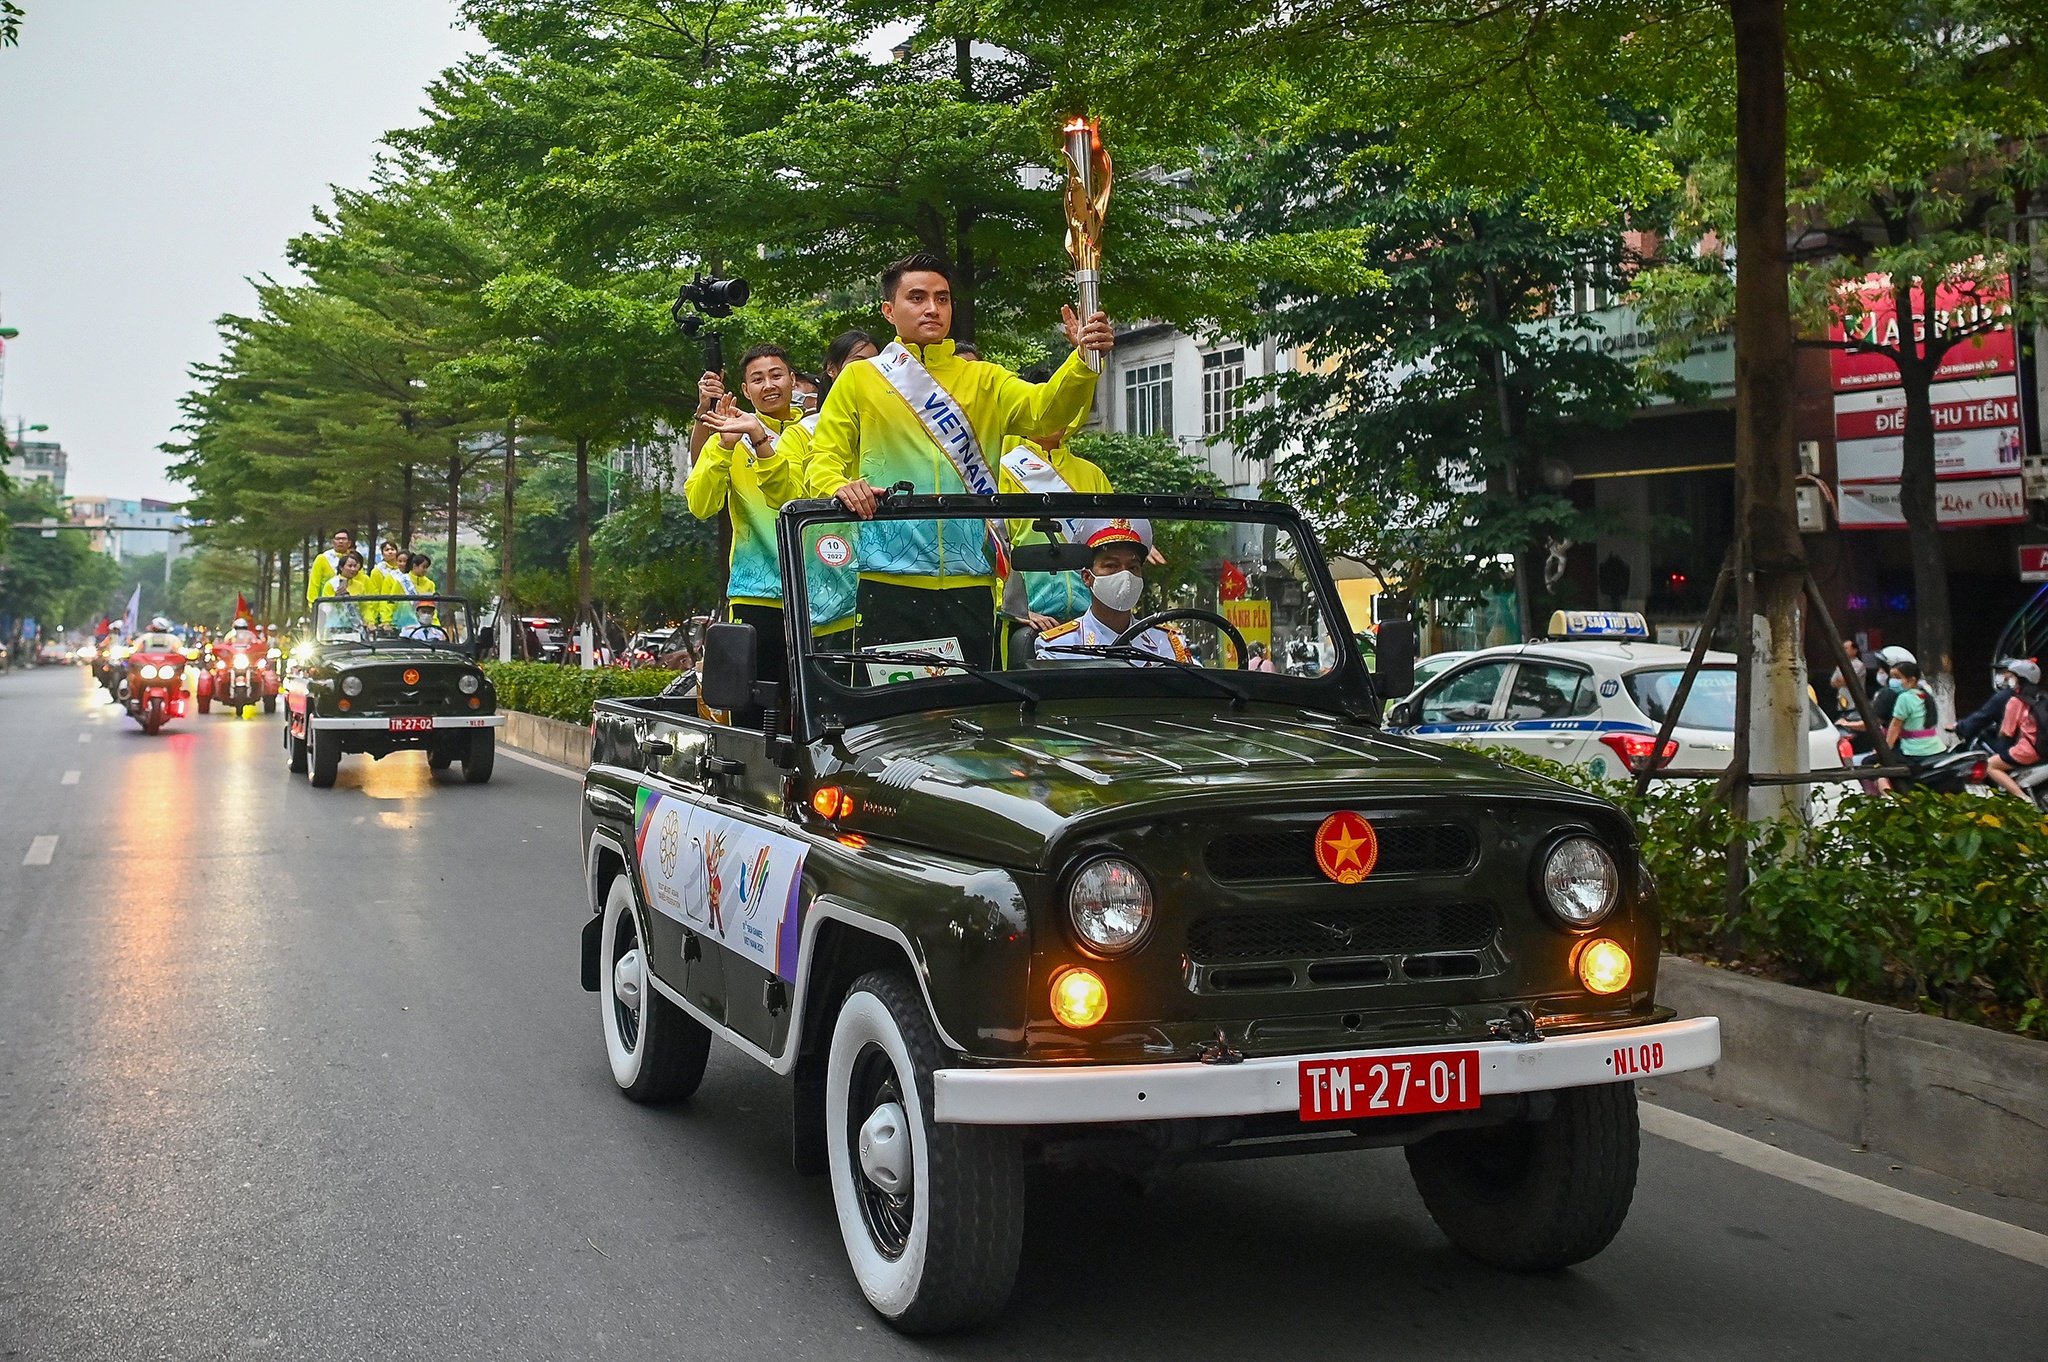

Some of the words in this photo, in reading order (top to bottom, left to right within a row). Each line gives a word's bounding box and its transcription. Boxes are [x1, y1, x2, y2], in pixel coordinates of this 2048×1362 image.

[1965, 400, 2008, 422] TIỀN
[923, 392, 995, 494] VIETNAM
[827, 541, 839, 550] 10
[391, 719, 432, 730] TM-27-02
[1613, 1042, 1664, 1076] NLQĐ
[1306, 1058, 1466, 1113] TM-27-01
